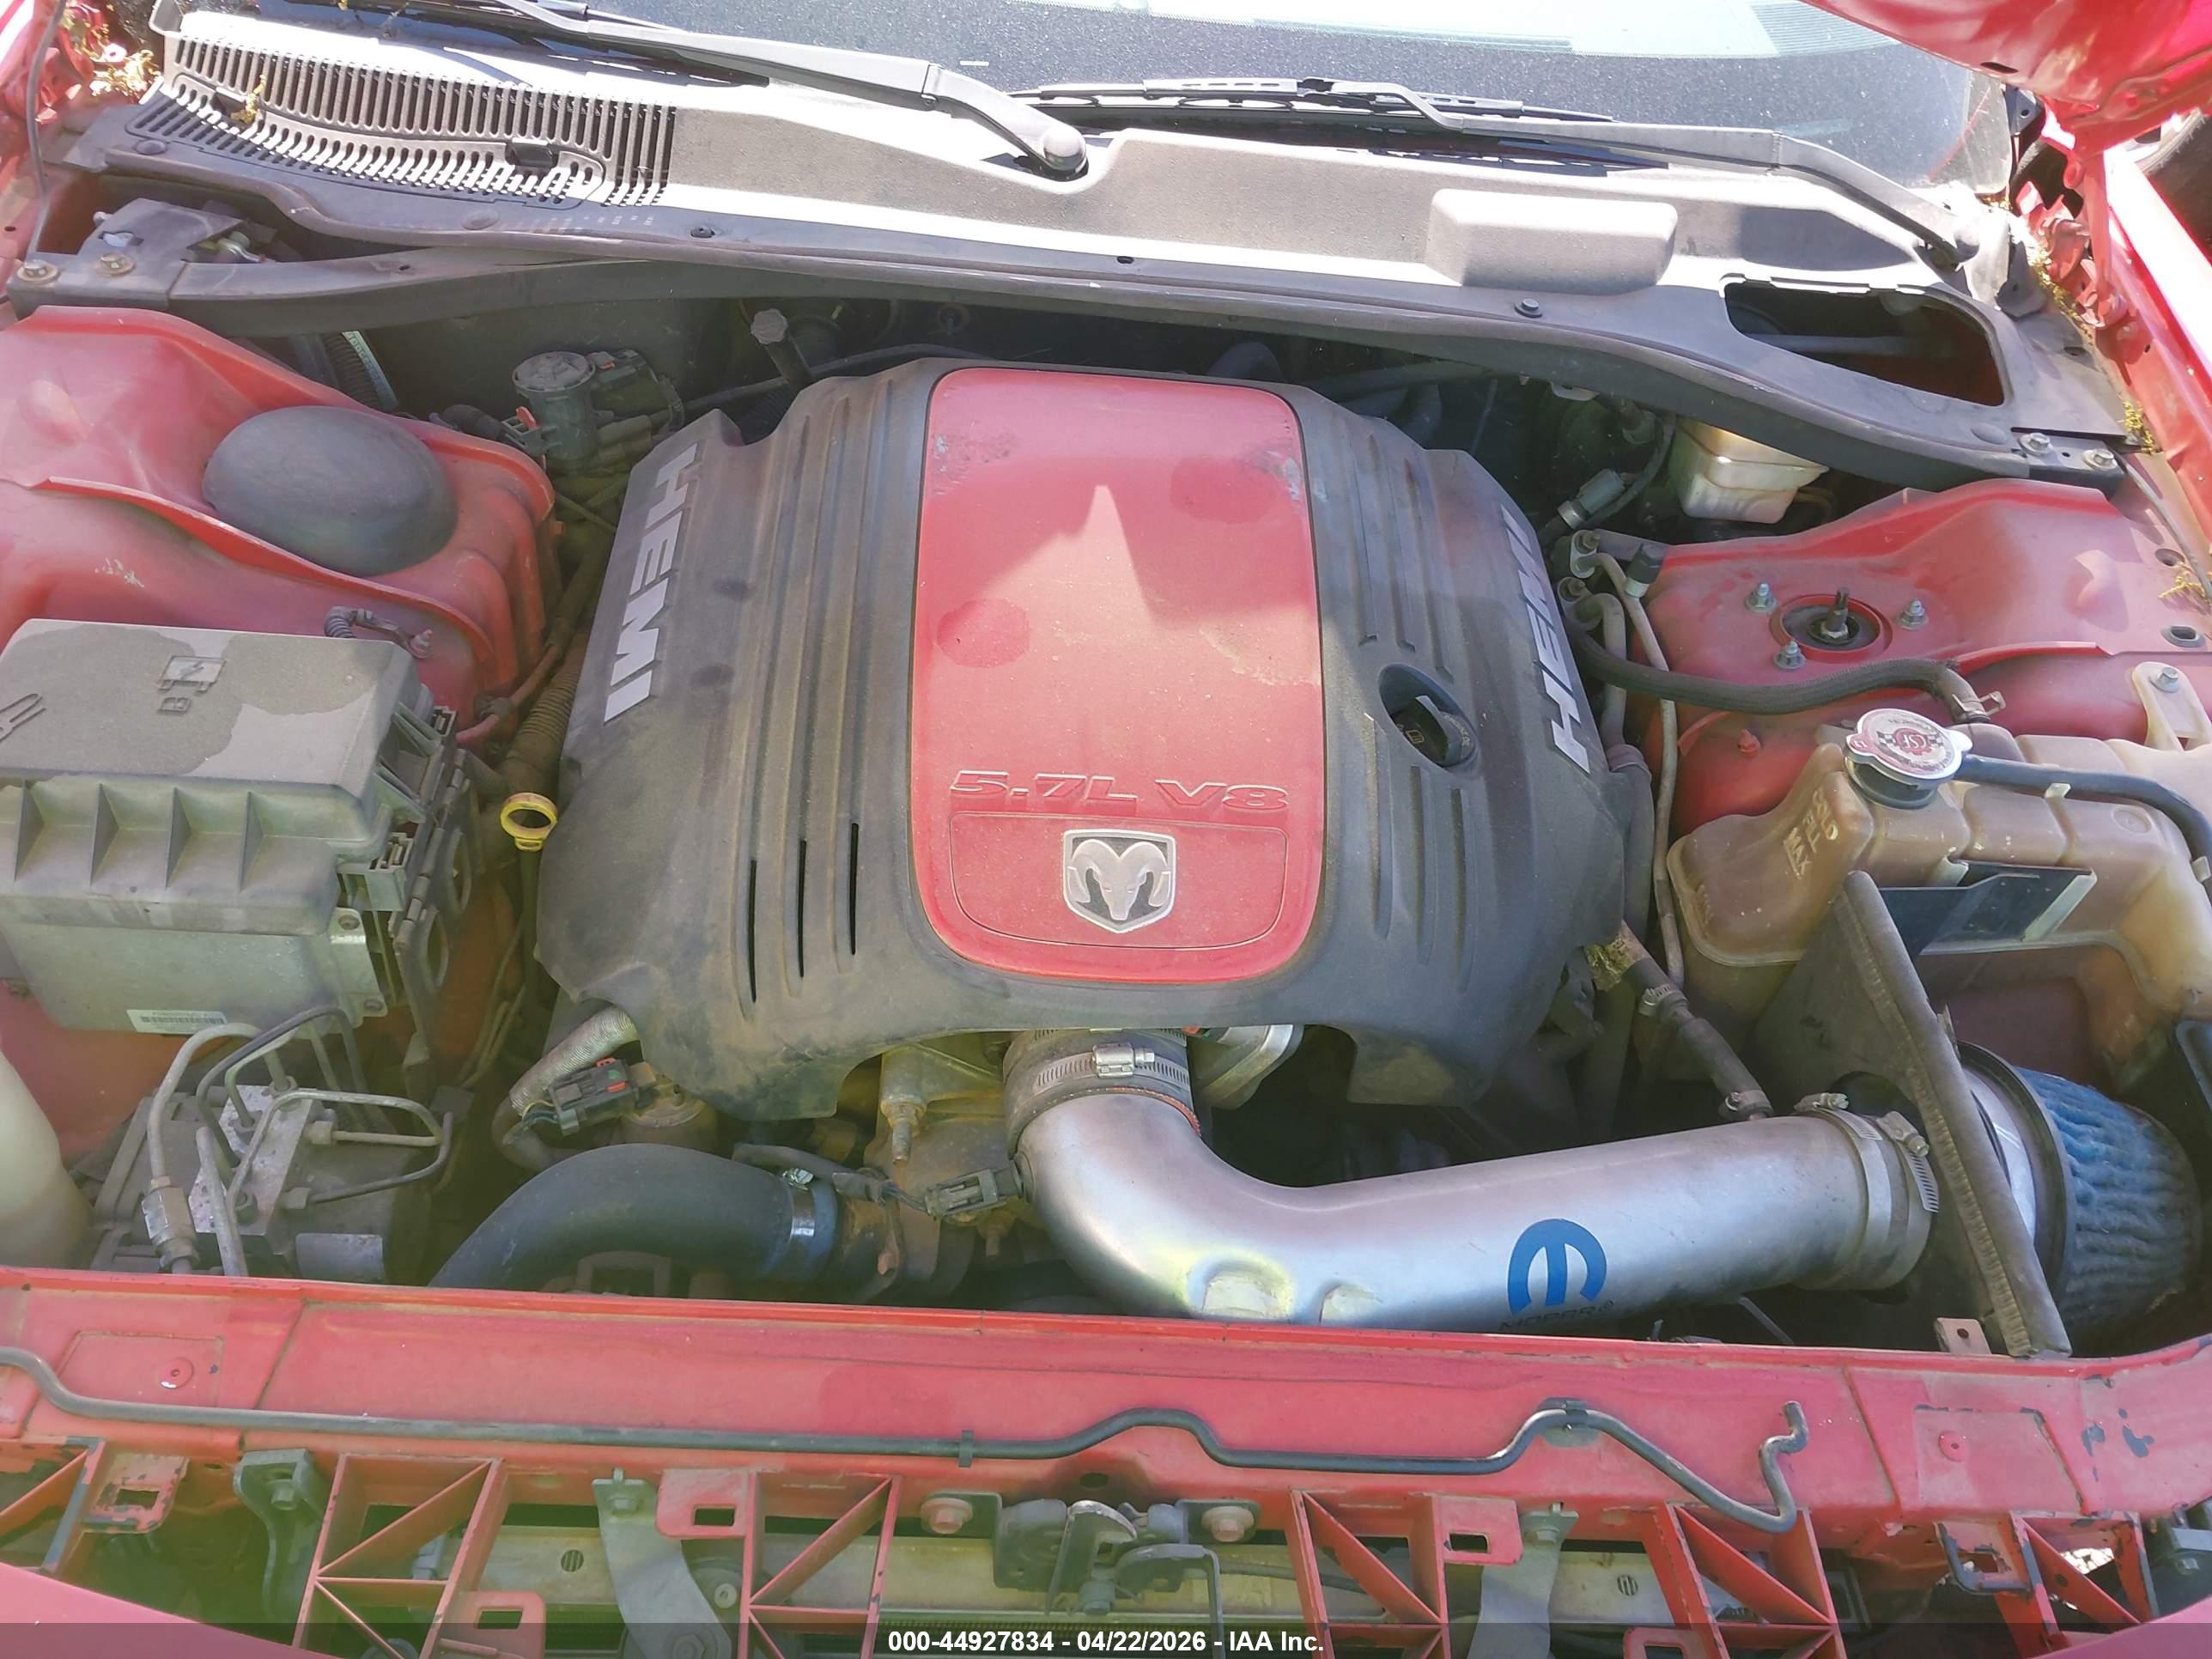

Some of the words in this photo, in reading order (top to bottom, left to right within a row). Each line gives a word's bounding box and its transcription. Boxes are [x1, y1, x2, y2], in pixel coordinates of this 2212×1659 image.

[604, 443, 697, 723] HEMI
[1500, 504, 1590, 775] HEMI
[950, 769, 1138, 801] 5.7L
[1154, 778, 1288, 811] V8
